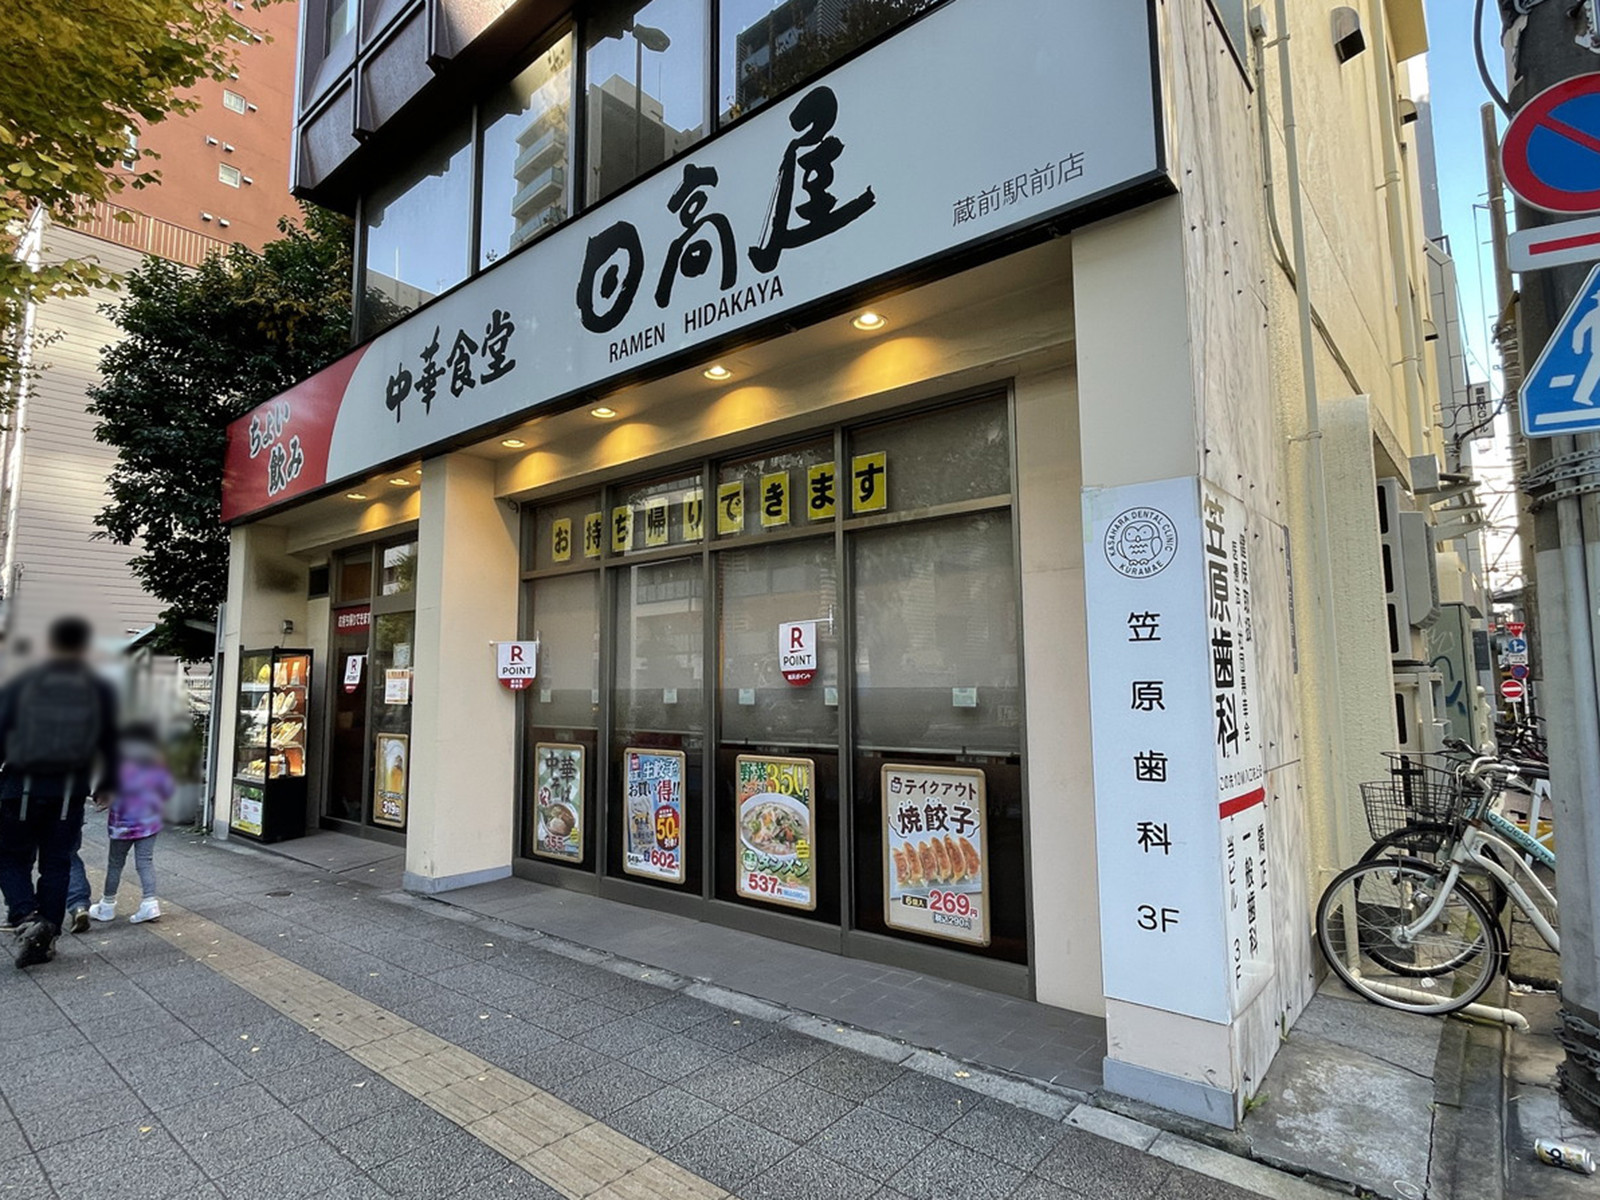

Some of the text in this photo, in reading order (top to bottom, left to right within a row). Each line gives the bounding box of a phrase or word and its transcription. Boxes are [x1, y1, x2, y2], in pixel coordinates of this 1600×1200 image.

[576, 86, 876, 333] 日高屋
[952, 151, 1085, 227] 蔵前駅前店
[609, 275, 784, 363] RAMEN HIDAKAYA
[385, 308, 517, 424] 中華食堂
[249, 401, 290, 459] ちょい
[267, 433, 304, 497] 飲み
[554, 463, 885, 555] お持ち帰りできます
[1107, 510, 1174, 557] KASAHARA DENTAL CLINIC
[1119, 560, 1164, 576] KURAMAE
[791, 626, 804, 649] R
[1204, 494, 1240, 758] 笠原歯科
[502, 666, 533, 675] POINT
[510, 645, 524, 661] R
[783, 654, 812, 666] POINT
[1127, 611, 1173, 856] 笠原歯科
[545, 751, 577, 785] 中華
[904, 779, 977, 800] テイクアウト
[897, 803, 975, 835] 焼餃子
[1137, 904, 1180, 933] 3F
